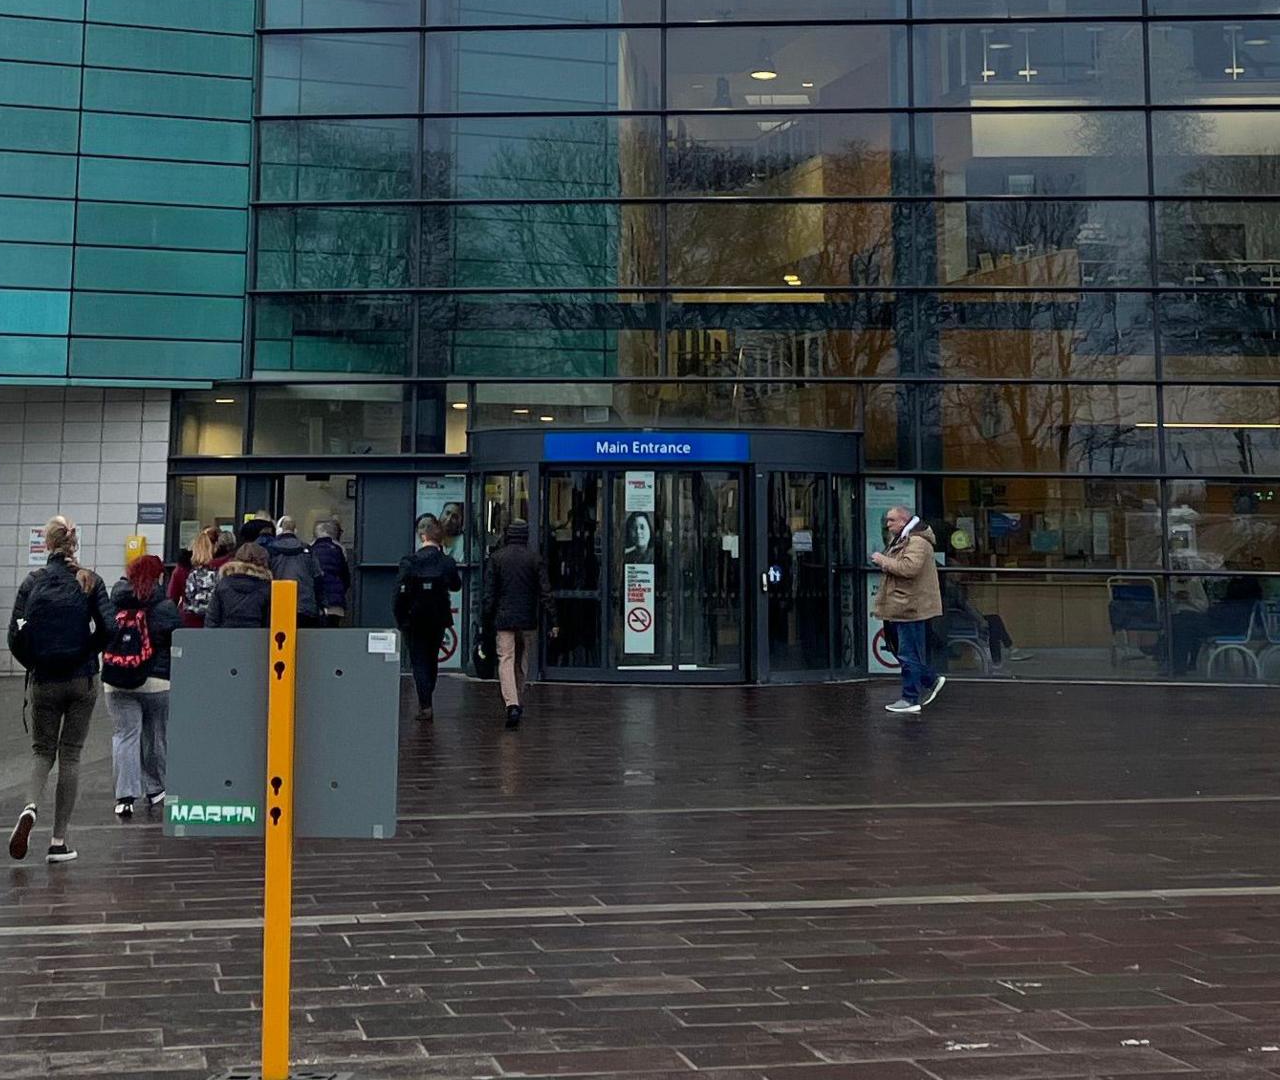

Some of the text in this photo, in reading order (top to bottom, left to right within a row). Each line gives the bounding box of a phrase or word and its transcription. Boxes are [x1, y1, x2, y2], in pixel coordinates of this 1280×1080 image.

[596, 441, 691, 454] Main Entrance
[171, 805, 256, 823] MARTIN
